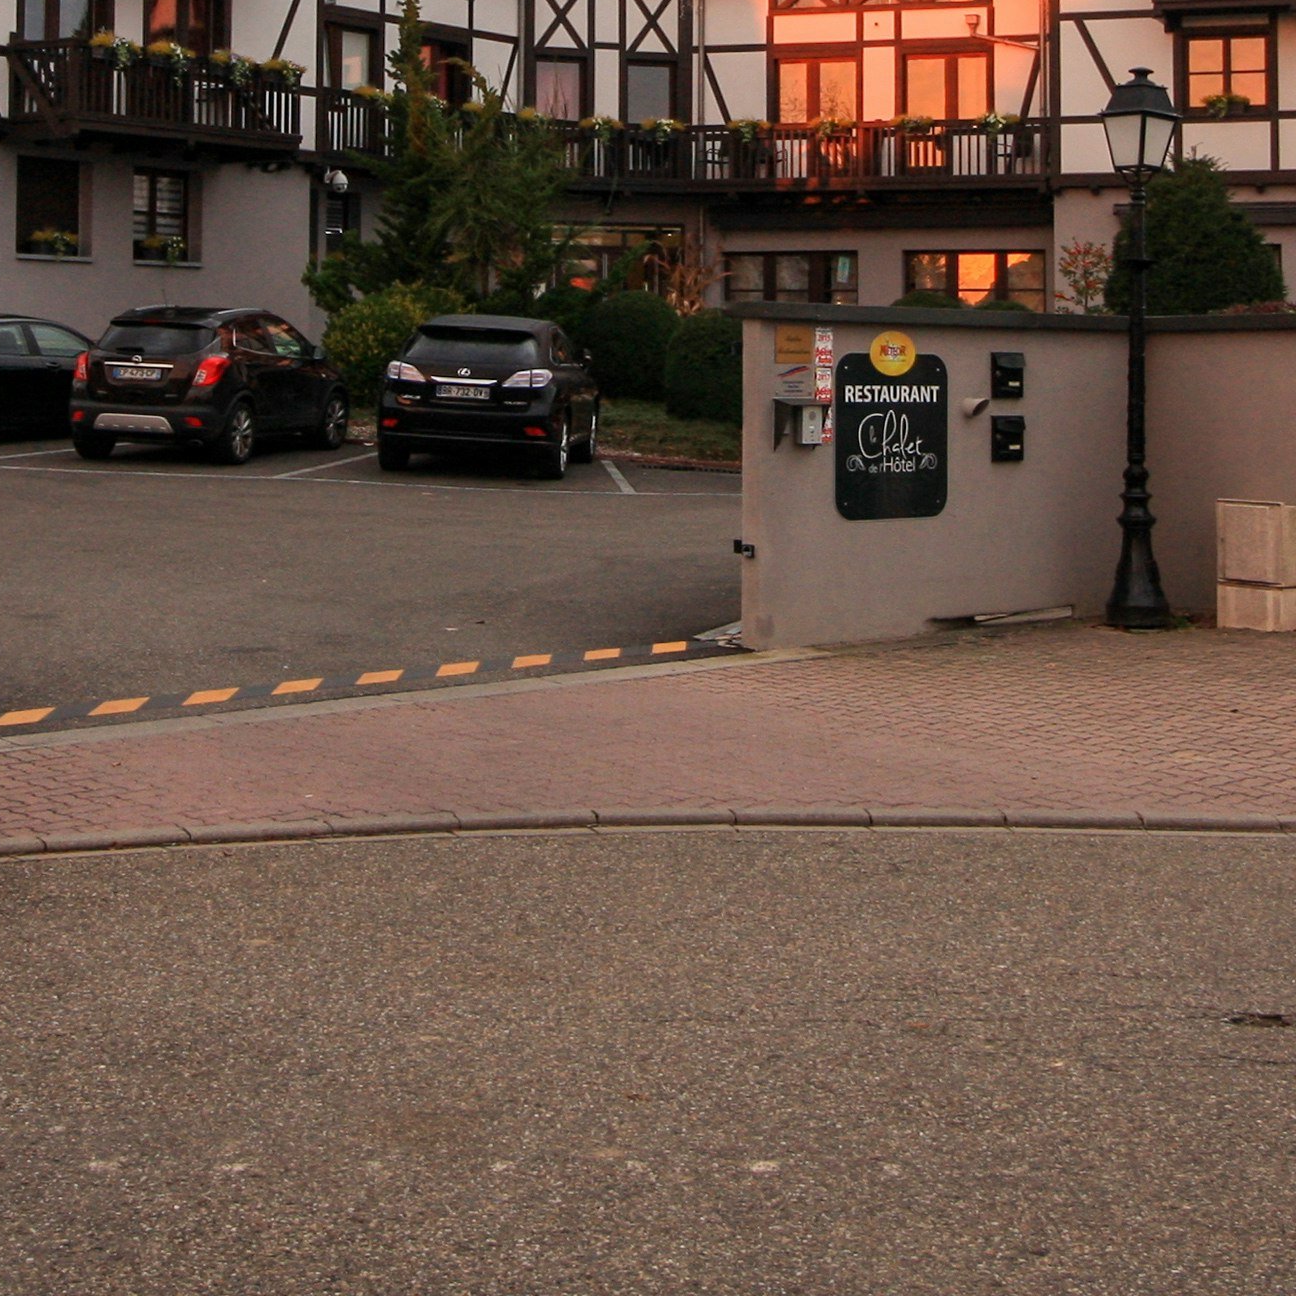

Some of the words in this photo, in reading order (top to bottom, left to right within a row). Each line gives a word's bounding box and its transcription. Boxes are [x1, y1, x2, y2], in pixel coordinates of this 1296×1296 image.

[844, 385, 940, 403] RESTAURANT
[858, 409, 923, 459] Chalet
[868, 464, 879, 474] de
